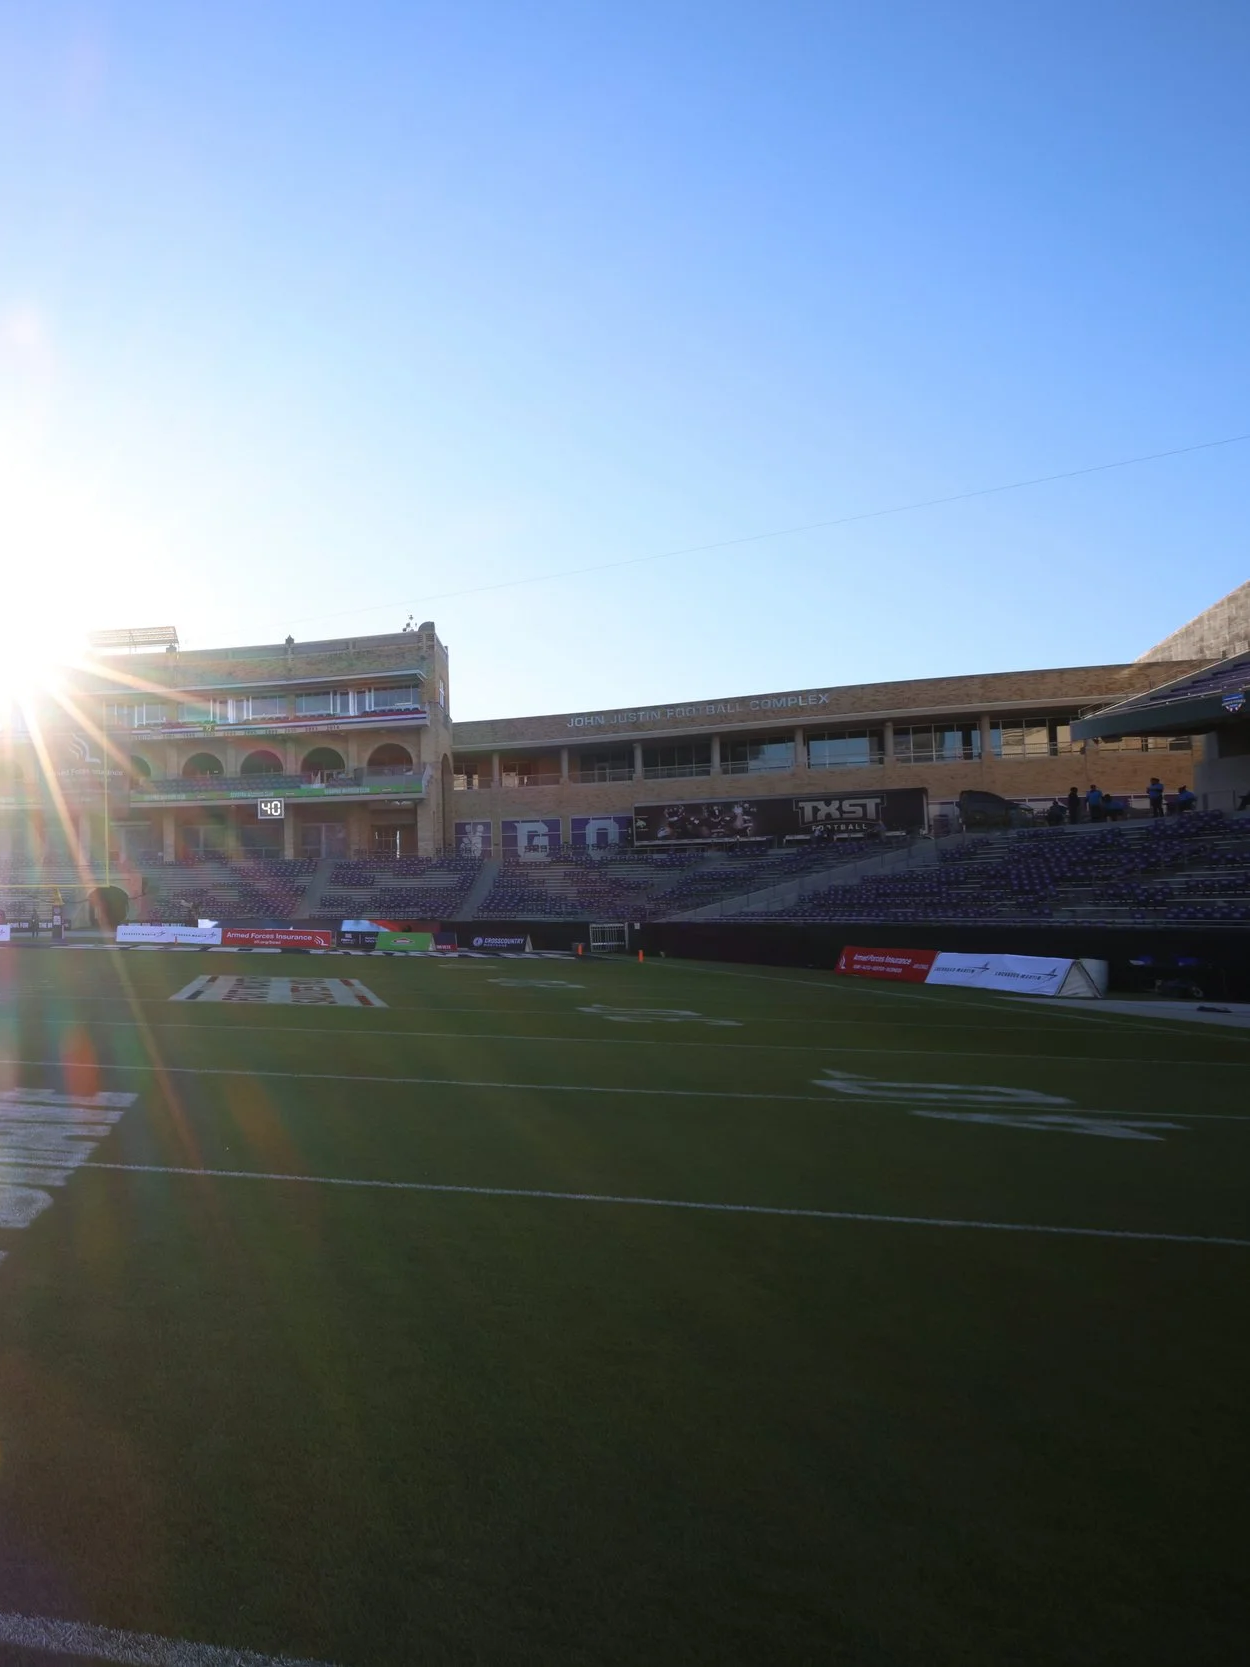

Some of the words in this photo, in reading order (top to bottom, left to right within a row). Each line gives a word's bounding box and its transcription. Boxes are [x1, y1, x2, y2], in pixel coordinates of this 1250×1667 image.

[566, 715, 605, 728] JOHN
[610, 710, 660, 725] JUSTIN
[749, 693, 830, 711] COMPLEX
[261, 801, 280, 815] 40
[797, 798, 881, 822] TXST
[811, 824, 868, 833] FOOTBALL
[226, 931, 250, 939] Armed
[276, 933, 312, 941] Insurance
[886, 956, 912, 965] Insurance
[1020, 972, 1042, 980] MARTIN
